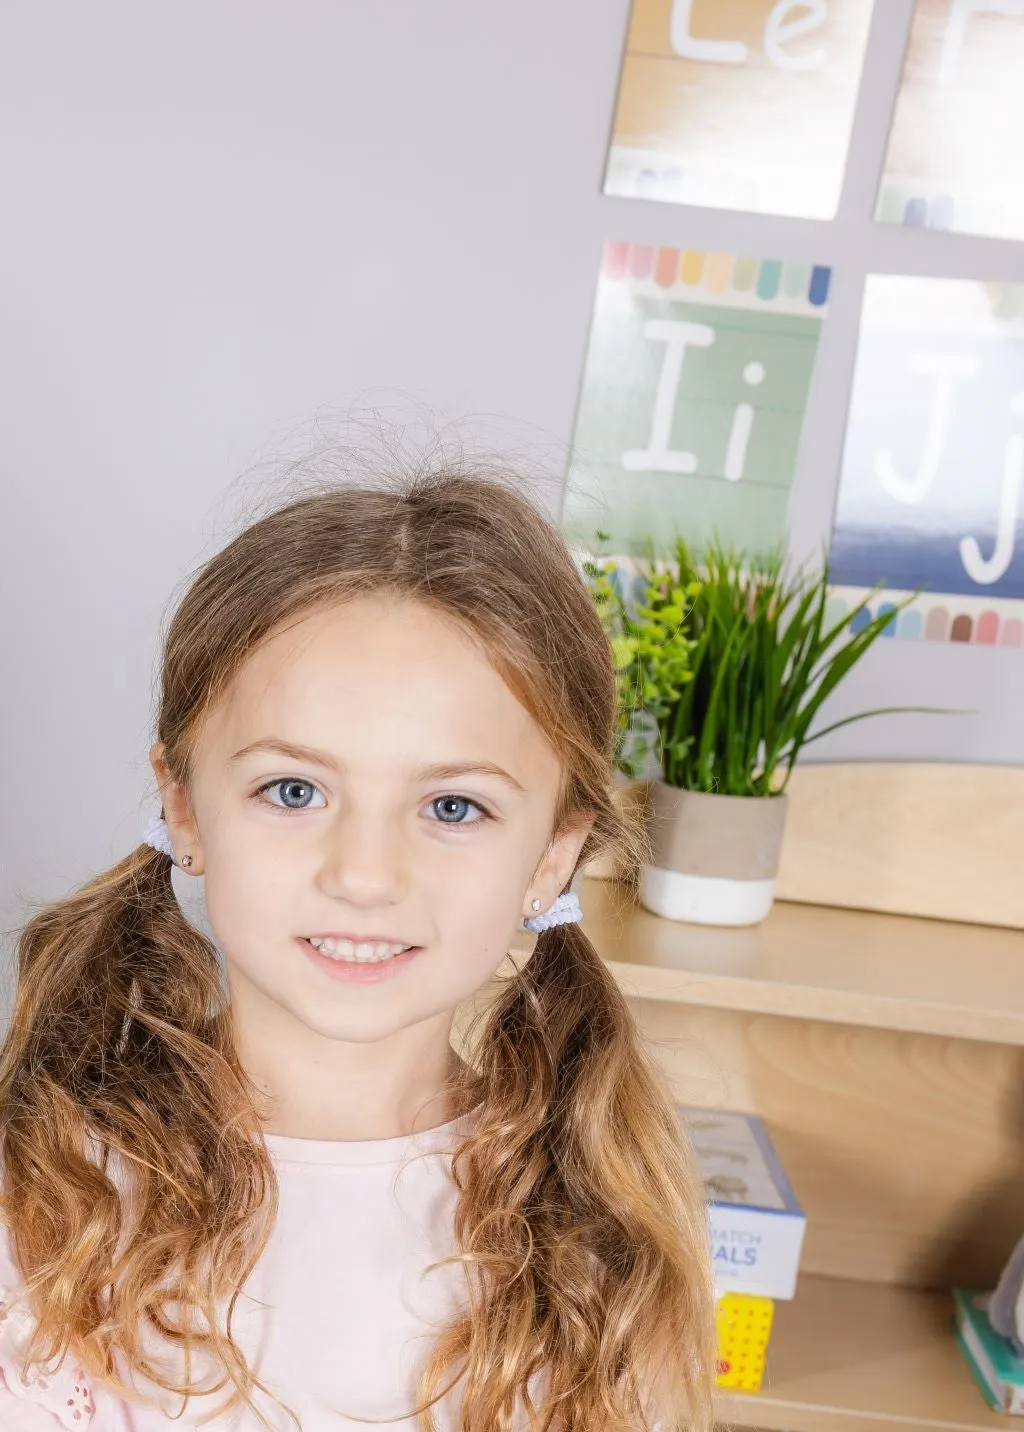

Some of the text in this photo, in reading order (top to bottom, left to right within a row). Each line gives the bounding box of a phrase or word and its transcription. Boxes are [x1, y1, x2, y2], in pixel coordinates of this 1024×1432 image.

[621, 319, 766, 482] Ii
[875, 353, 1024, 585] Jj
[711, 1244, 758, 1266] ALS
